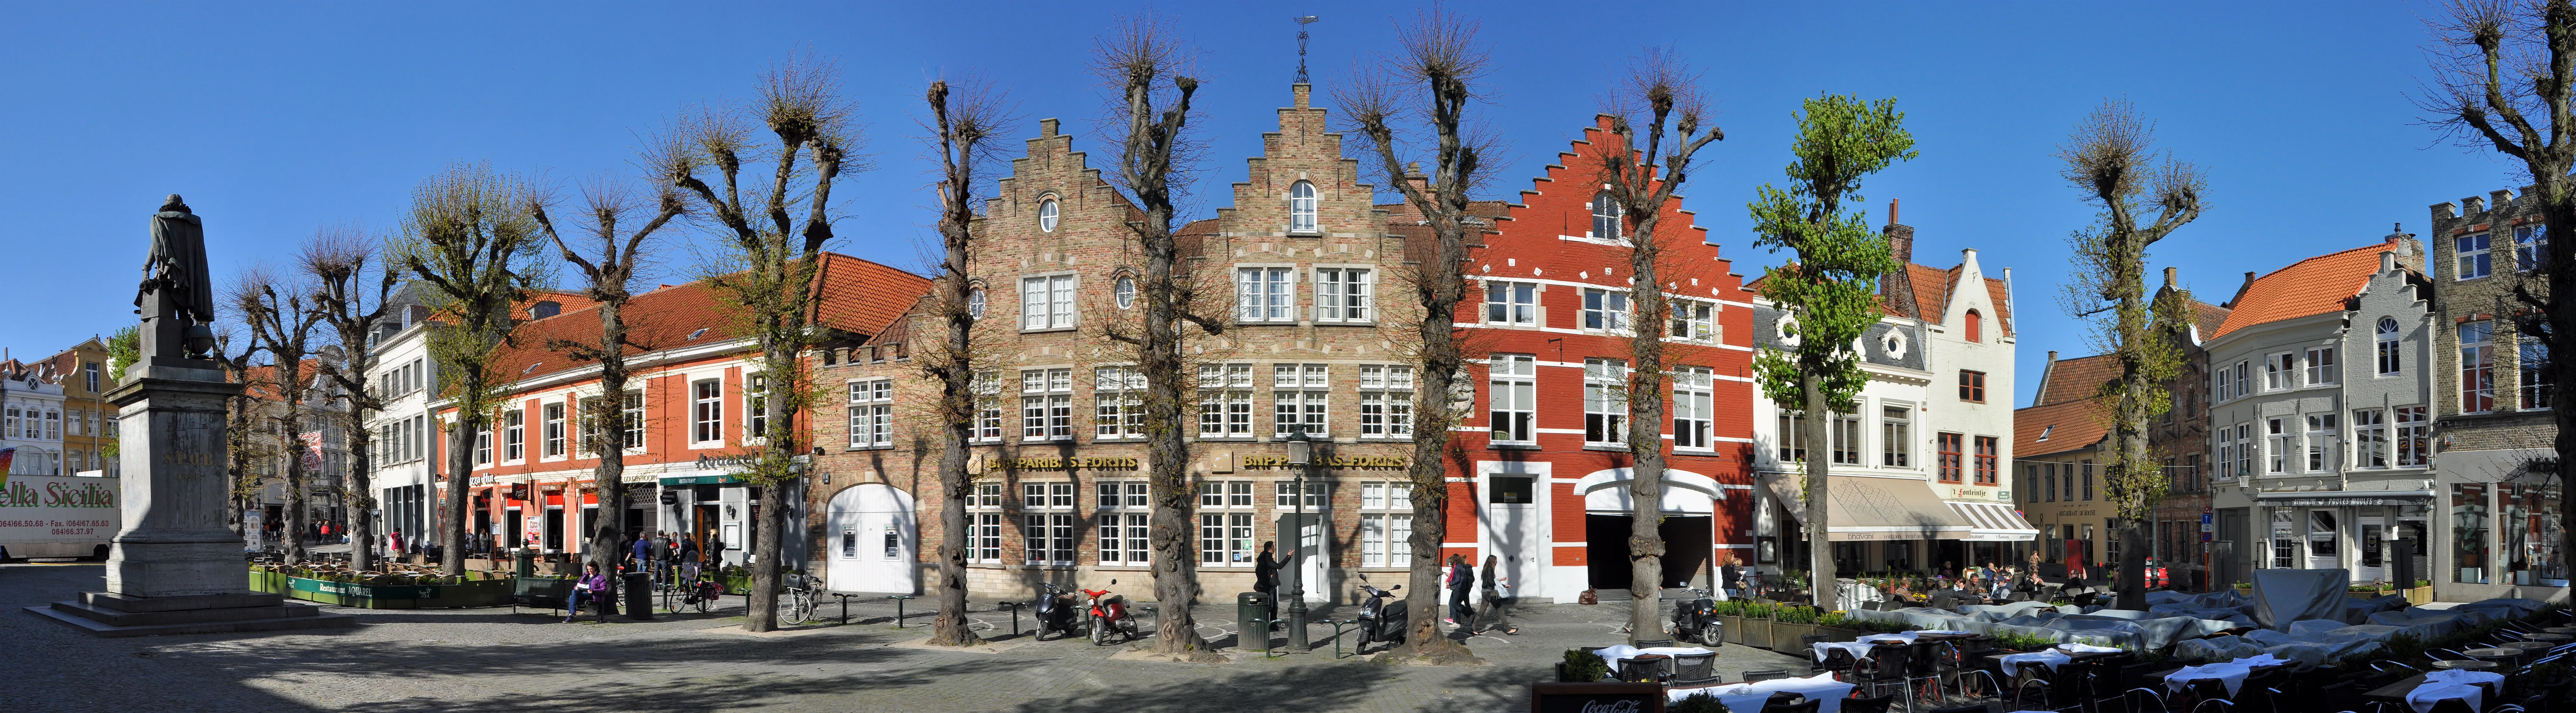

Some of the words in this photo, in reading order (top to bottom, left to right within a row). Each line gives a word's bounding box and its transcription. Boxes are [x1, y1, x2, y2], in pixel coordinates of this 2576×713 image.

[988, 458, 1014, 468] BNP
[1018, 457, 1077, 468] PARIBAS
[1084, 456, 1136, 467] FORTIS
[1243, 455, 1274, 466] BNP
[1278, 455, 1342, 466] PIBAS
[1351, 456, 1405, 467] FORTIS
[469, 476, 481, 485] izza
[481, 473, 494, 483] Hut
[45, 482, 114, 508] Sicilia
[1958, 488, 1986, 497] Fonteintje
[319, 583, 345, 593] Restaurant
[348, 586, 372, 597] AQUAREL
